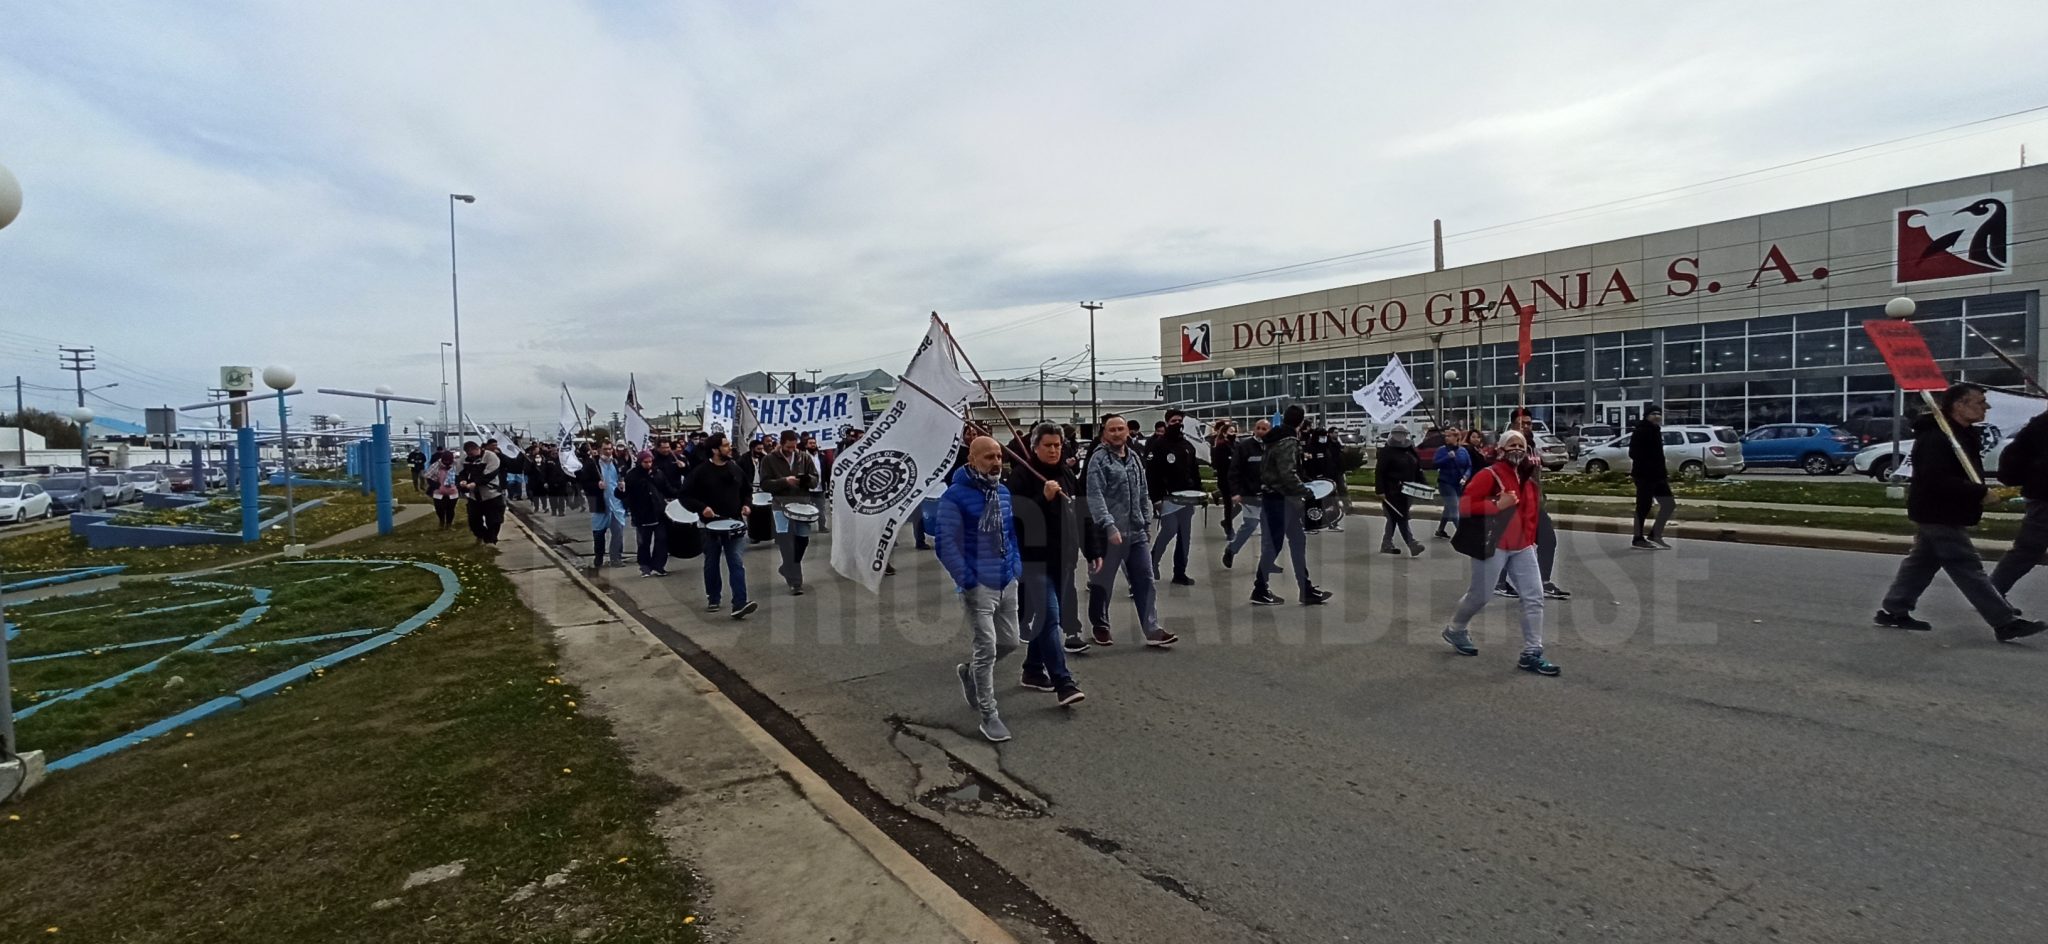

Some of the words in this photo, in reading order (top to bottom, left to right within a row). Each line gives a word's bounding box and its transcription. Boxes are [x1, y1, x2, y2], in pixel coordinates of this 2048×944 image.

[1233, 300, 1407, 350] DOMINGO
[1425, 268, 1639, 326] GRANJA
[1667, 257, 1721, 296] S.
[1747, 244, 1829, 288] A.
[712, 389, 848, 424] BRGHTSTAR
